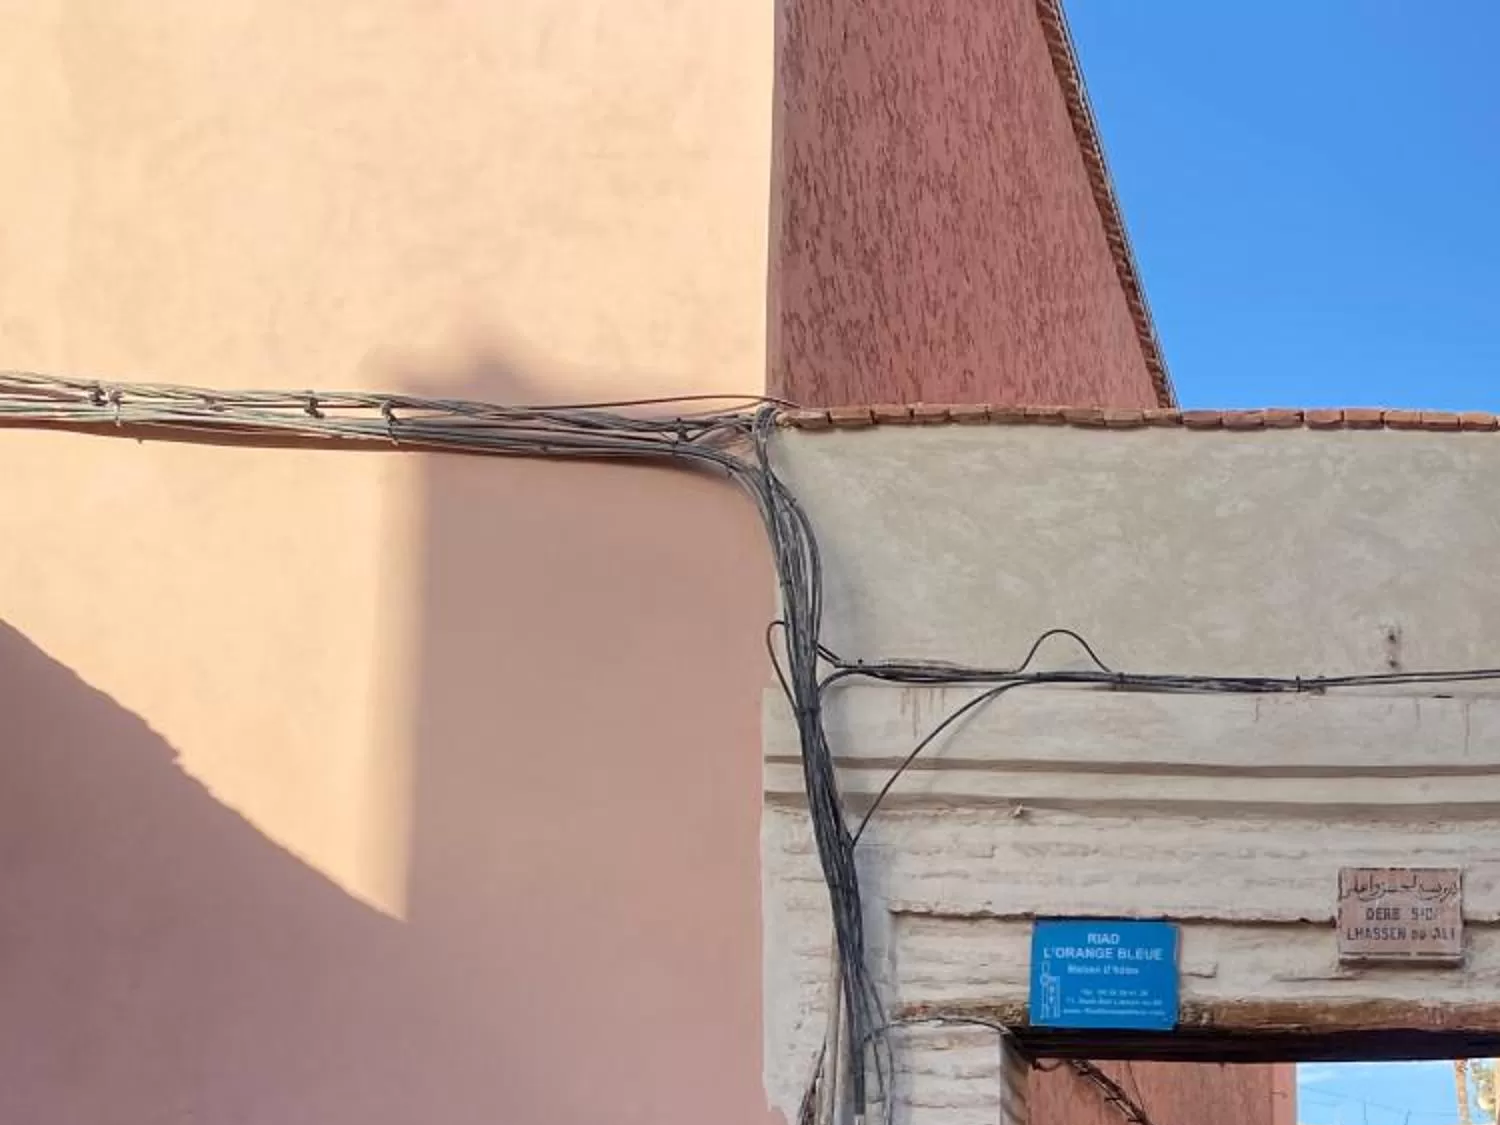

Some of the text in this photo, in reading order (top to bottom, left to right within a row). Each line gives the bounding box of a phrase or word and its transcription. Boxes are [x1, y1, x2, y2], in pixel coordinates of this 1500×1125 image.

[1087, 933, 1120, 945] RIAD
[1043, 947, 1165, 961] L'ORANGE BLEUE
